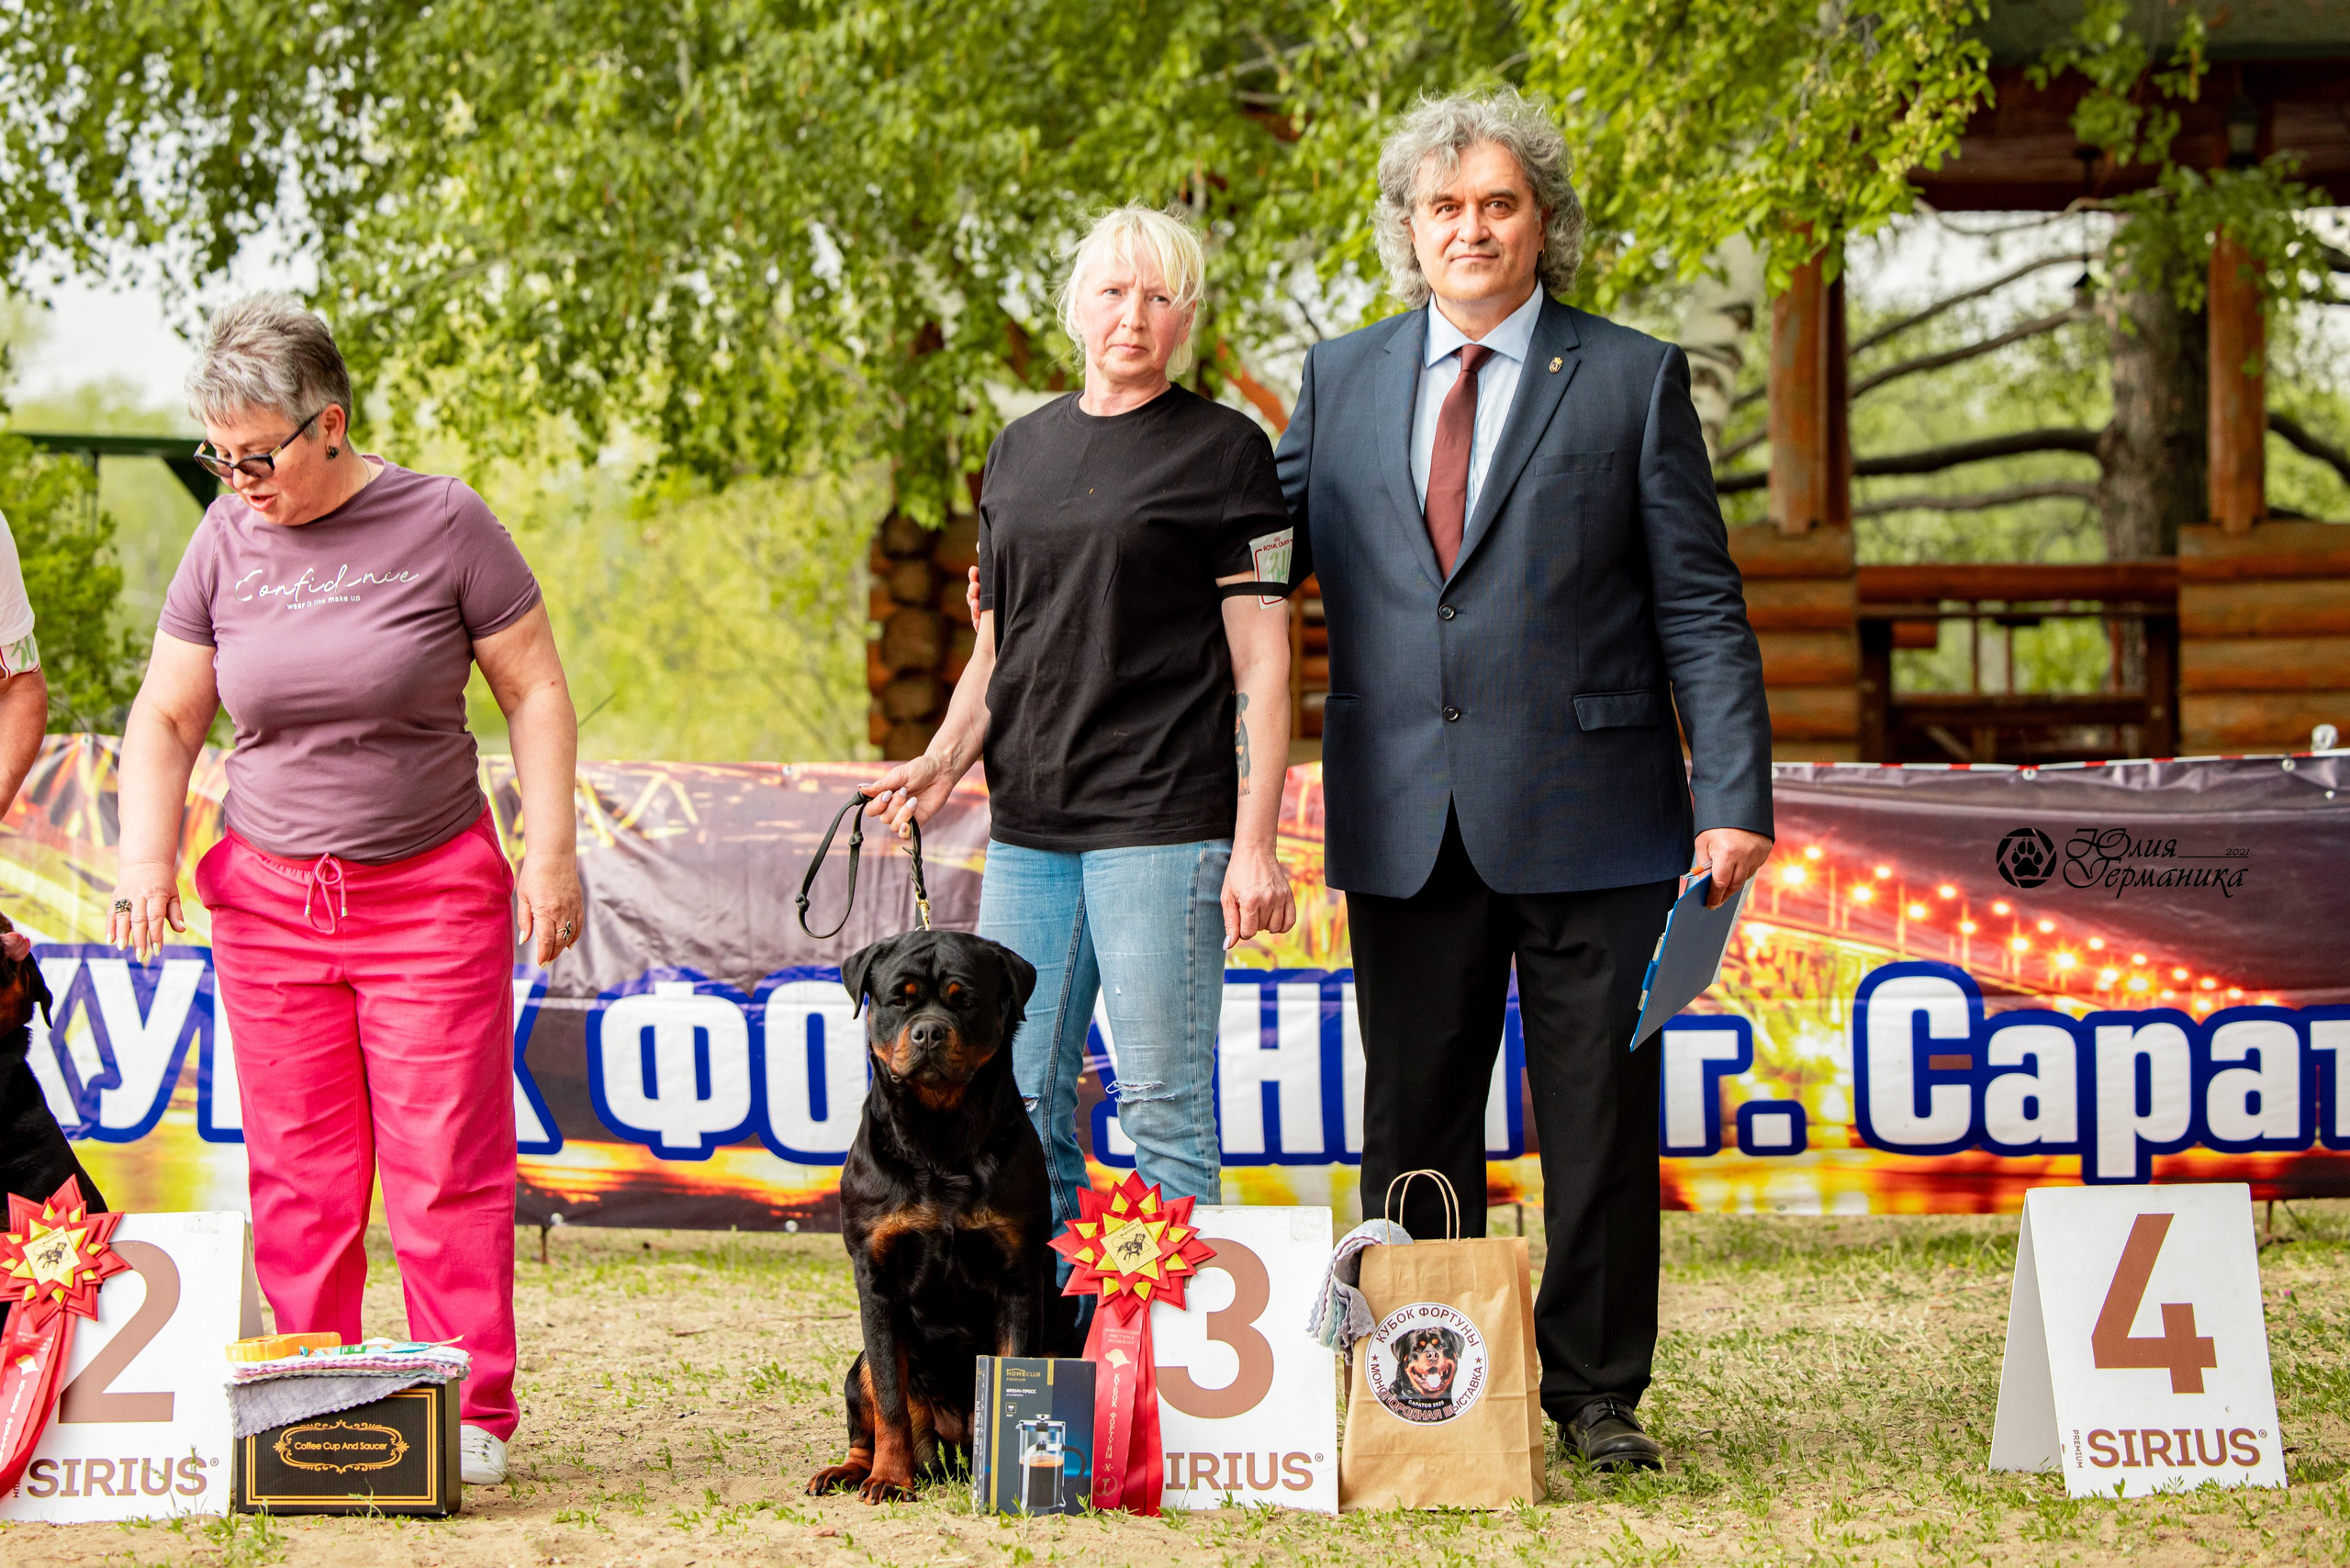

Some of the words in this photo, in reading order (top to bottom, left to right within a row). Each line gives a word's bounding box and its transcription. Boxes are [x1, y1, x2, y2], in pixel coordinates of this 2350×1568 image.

[328, 595, 348, 603] make
[2090, 1212, 2218, 1394] 4
[58, 1239, 182, 1424] 2
[1154, 1237, 1274, 1419] 3
[1375, 1307, 1416, 1344] КУБОК
[1418, 1306, 1480, 1347] ФОРТУНЫ
[1111, 1372, 1120, 1408] КУБОК
[1370, 1363, 1442, 1421] МОНОПОРОДНАЯ
[1443, 1365, 1483, 1417] ВЫСТАВКА
[1407, 1399, 1432, 1408] САРАТОВ
[1432, 1400, 1445, 1408] 2025
[294, 1441, 322, 1450] Coffee
[322, 1441, 341, 1452] Cup
[341, 1441, 359, 1450] And
[359, 1441, 388, 1450] Saucer
[1105, 1411, 1117, 1459] ФОРТУНЫ
[2072, 1428, 2084, 1469] PREMIUM
